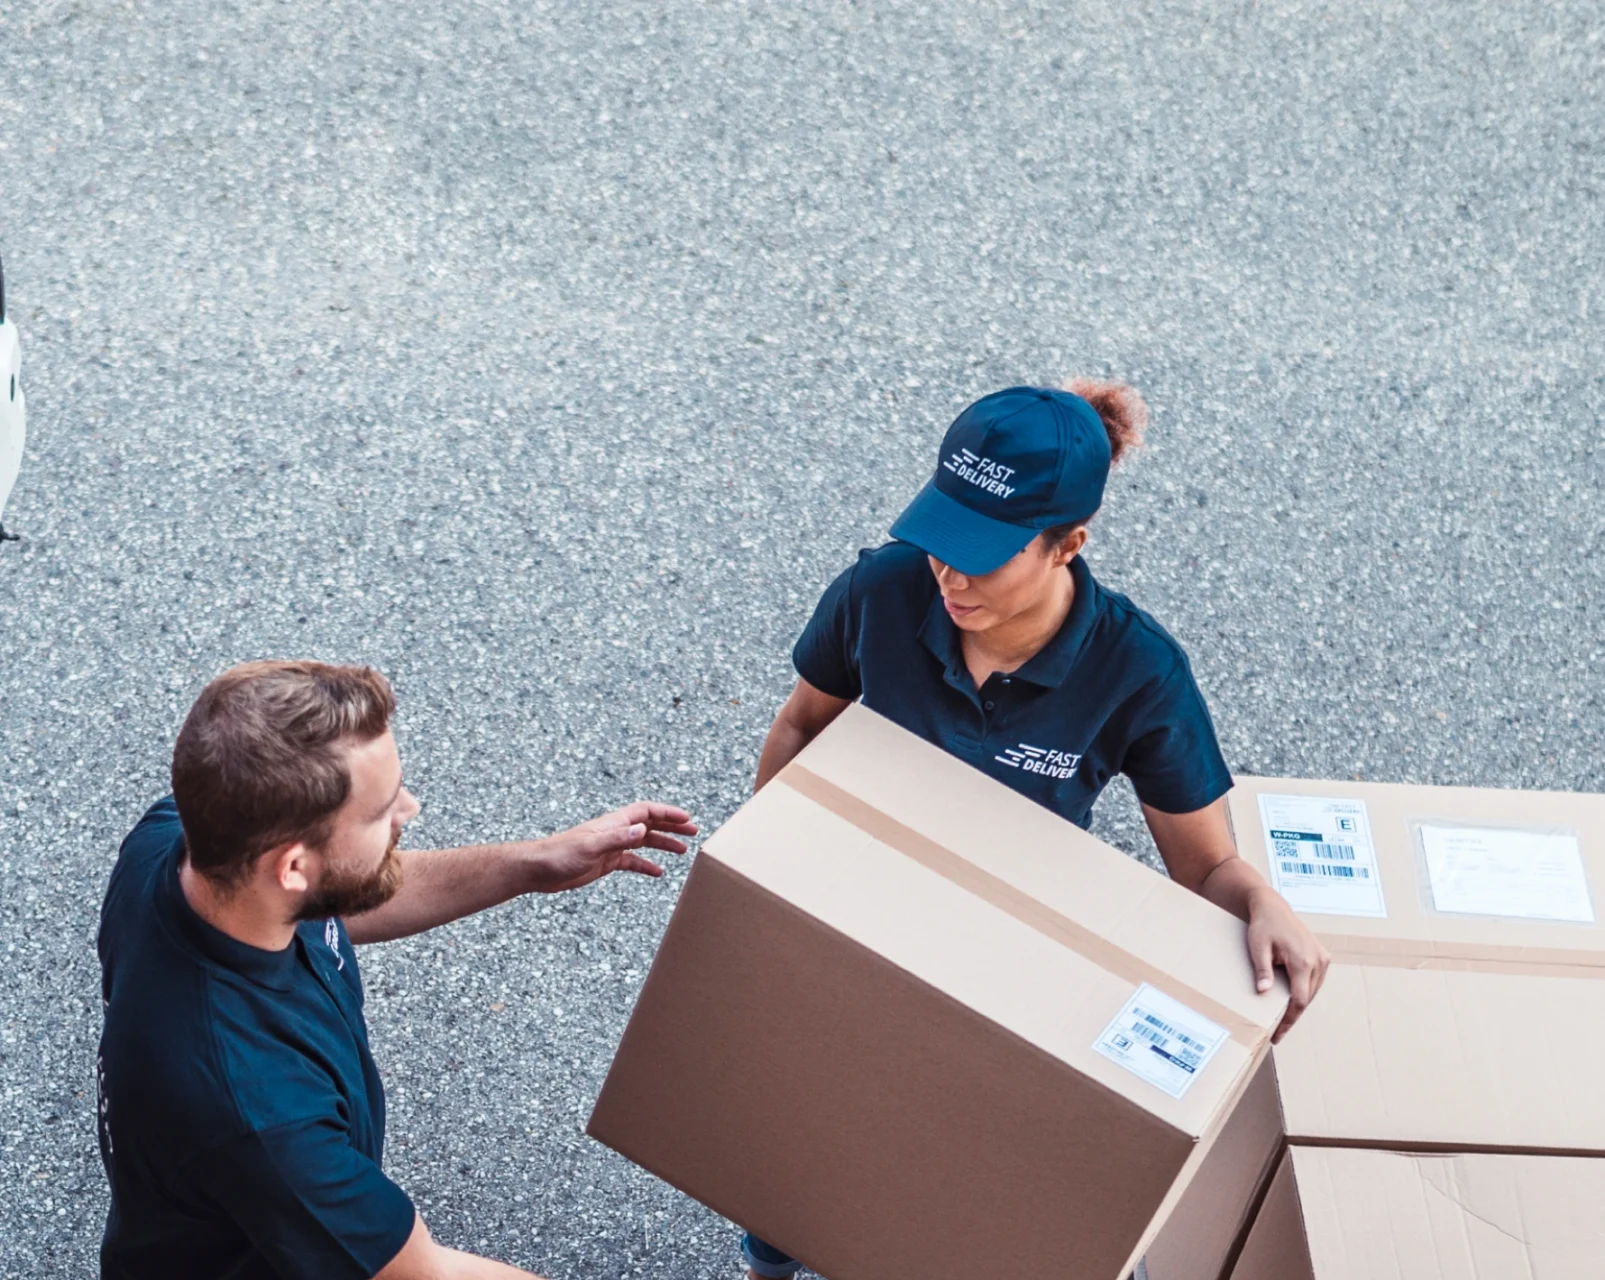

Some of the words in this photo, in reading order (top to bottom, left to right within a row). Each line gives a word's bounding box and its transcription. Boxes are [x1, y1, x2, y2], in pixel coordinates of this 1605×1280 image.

[977, 457, 1015, 482] FAST
[956, 464, 1016, 499] DELIVERY
[1022, 758, 1078, 779] DELIVER
[1044, 749, 1082, 768] FAST
[1340, 819, 1352, 830] E
